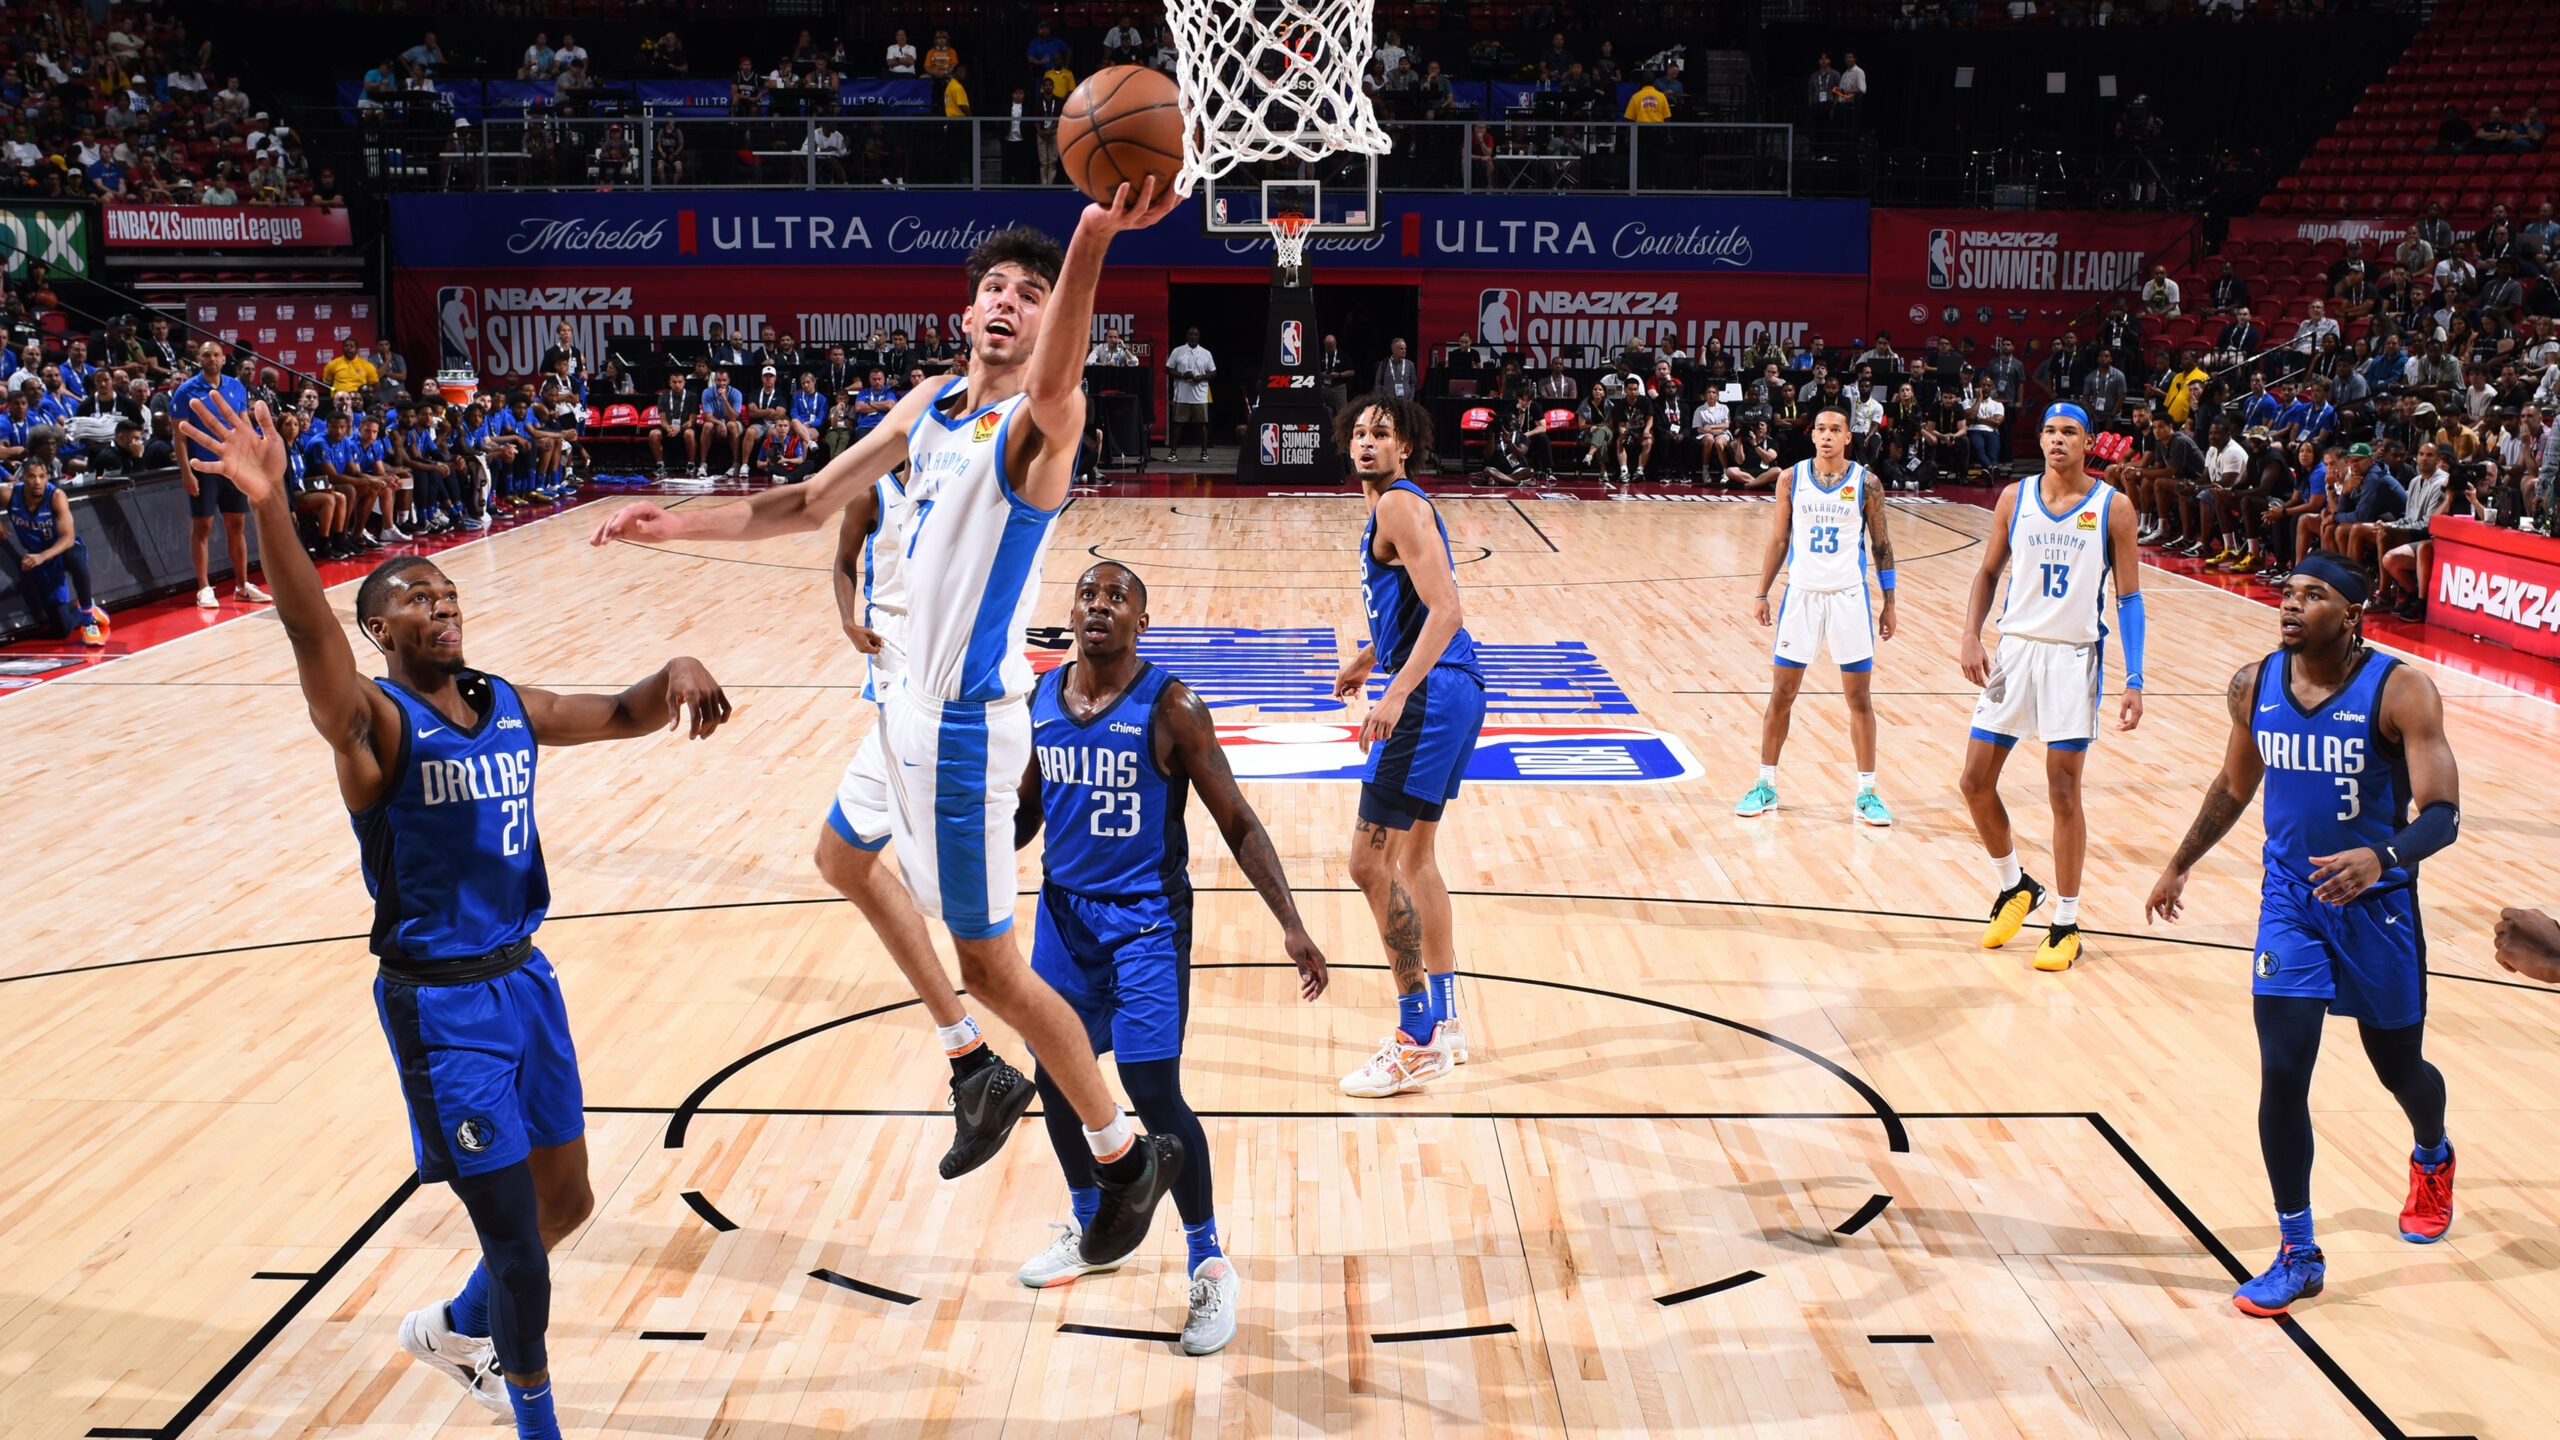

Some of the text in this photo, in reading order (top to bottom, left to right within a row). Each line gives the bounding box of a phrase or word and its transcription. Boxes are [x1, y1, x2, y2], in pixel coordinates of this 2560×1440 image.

[107, 210, 303, 245] #NBA2KSummerLeague
[507, 215, 1015, 254] Michelob ULTRA Courtsi
[1960, 231, 2058, 248] NBA2K24
[1436, 219, 1753, 266] ULTRA Courtside
[1959, 250, 2145, 292] SUMMER LEAGUE
[484, 287, 633, 311] NBA2K24
[1528, 291, 1679, 315] NBA2K24
[1132, 343, 1148, 354] EXIT
[1284, 354, 1294, 363] NBA
[1267, 375, 1315, 389] 2K24
[1282, 432, 1320, 448] SUMMER
[913, 452, 970, 477] KLAHOMA
[1282, 448, 1314, 465] LEAGUE
[1802, 502, 1851, 517] OKLAHOMA
[1816, 515, 1836, 524] CITY
[906, 500, 936, 559] 7
[1810, 526, 1840, 554] 23
[2028, 532, 2086, 551] OKLAHOMA
[2044, 548, 2068, 561] CITY
[2040, 563, 2070, 599] 13
[2439, 562, 2560, 633] NBA2K24
[496, 716, 523, 729] chime
[1109, 721, 1142, 735] chime
[2333, 710, 2366, 723] chime
[2257, 730, 2365, 775] DALLAS
[421, 749, 531, 806] DALLAS
[1036, 745, 1138, 789] DALLAS
[2334, 777, 2360, 822] 3
[1090, 790, 1141, 837] 23
[501, 798, 529, 857] 27
